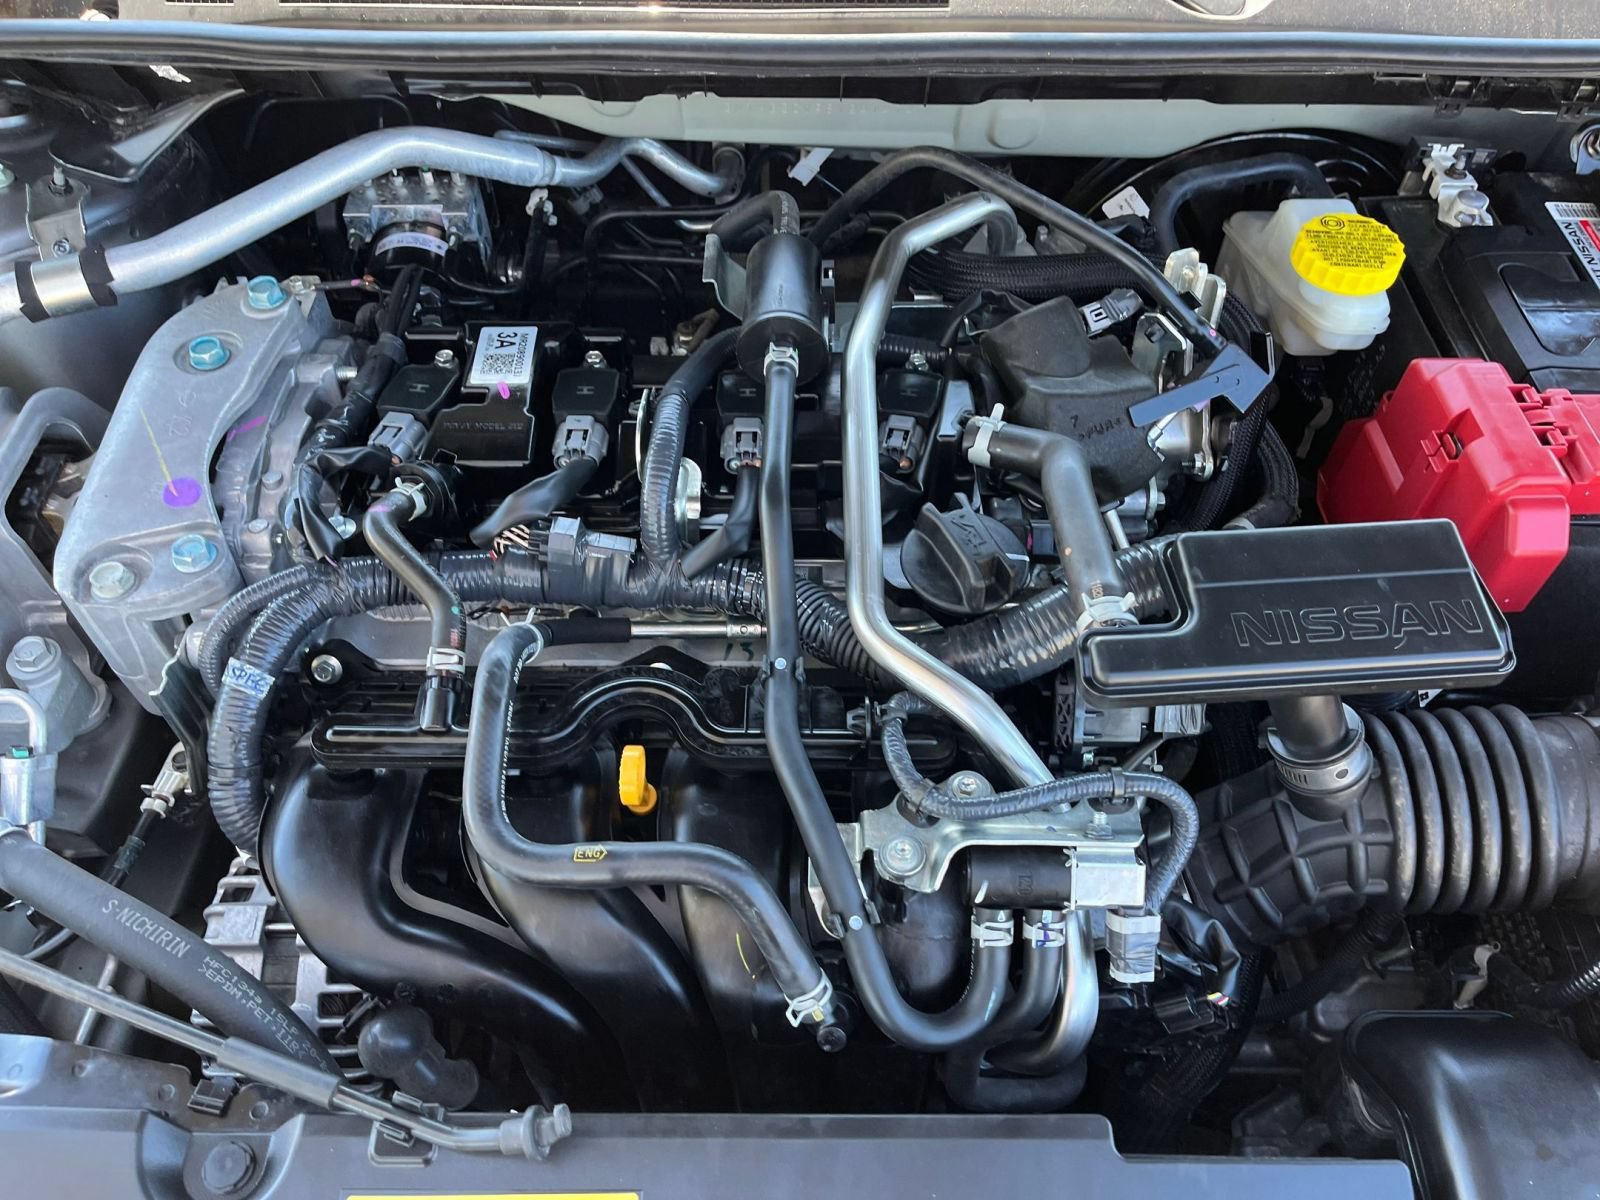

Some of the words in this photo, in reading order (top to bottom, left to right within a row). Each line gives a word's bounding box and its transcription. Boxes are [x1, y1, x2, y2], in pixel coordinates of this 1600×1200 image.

[1562, 221, 1598, 265] NISSAN
[494, 331, 518, 350] 3A
[1230, 600, 1484, 647] NISSAN
[577, 846, 601, 859] ENG
[102, 899, 191, 958] S-NICHIRIN
